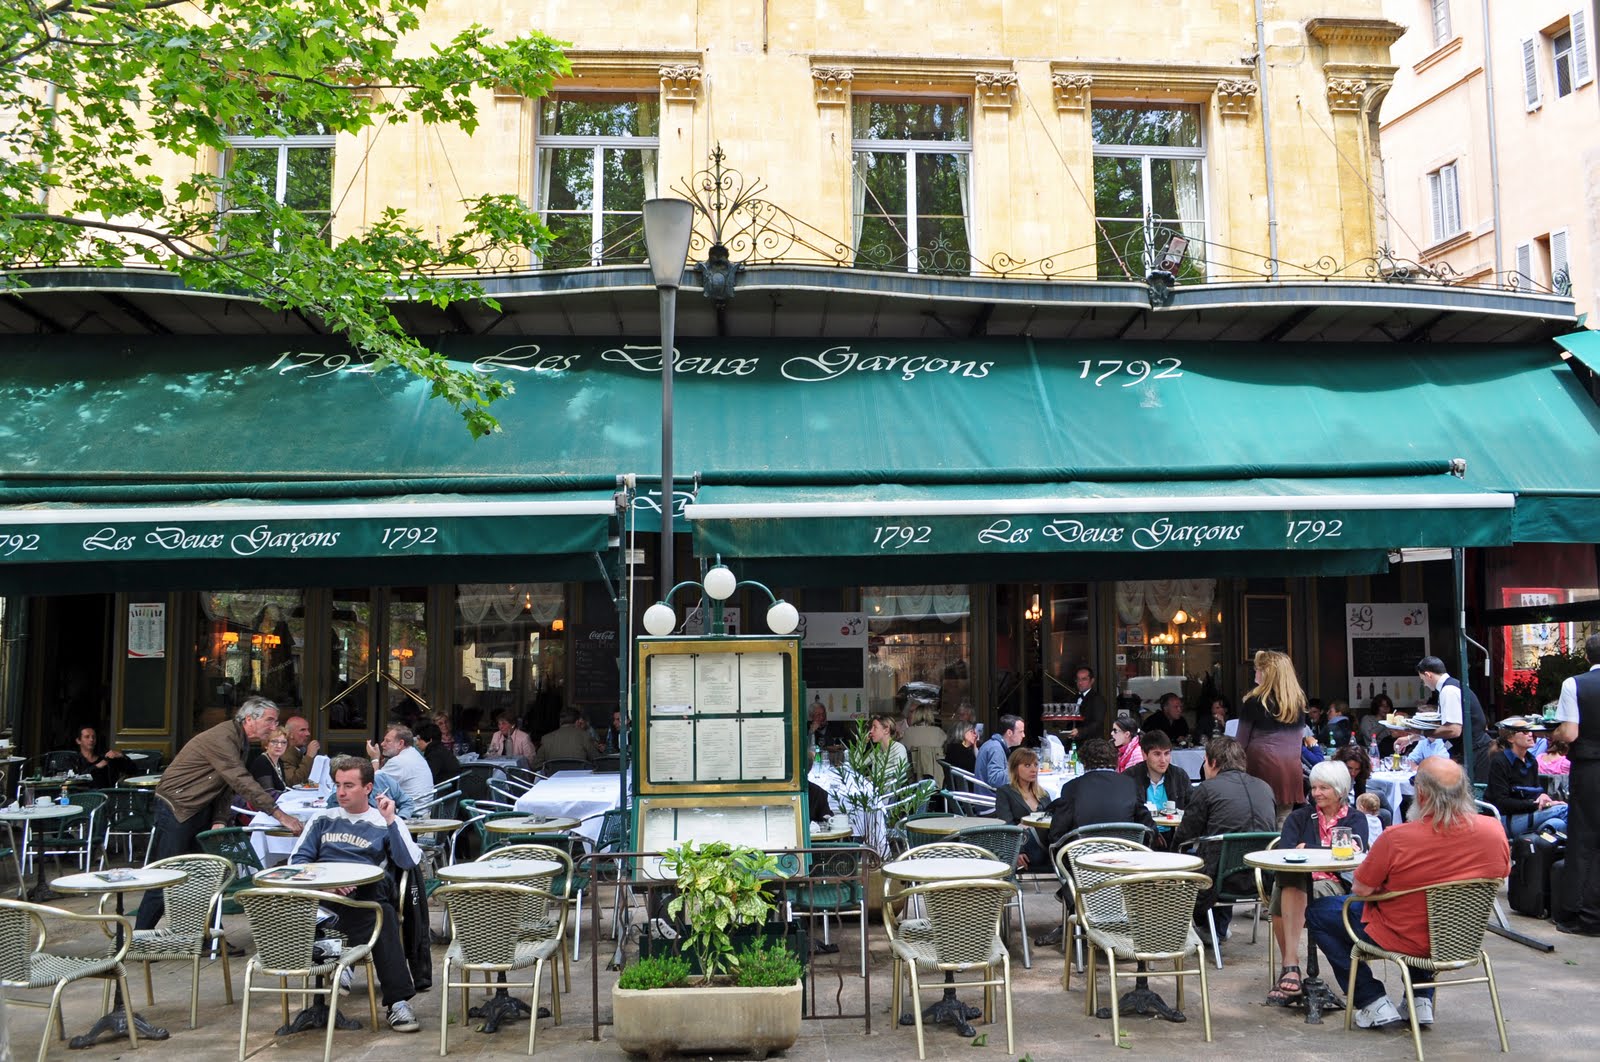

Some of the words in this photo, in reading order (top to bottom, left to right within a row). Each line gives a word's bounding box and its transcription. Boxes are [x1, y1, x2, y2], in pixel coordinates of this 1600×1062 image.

[267, 351, 385, 378] 1792
[472, 344, 581, 372] Les
[600, 344, 760, 376] Deux
[780, 346, 995, 382] Garçons
[1078, 358, 1183, 387] 1792
[82, 527, 136, 551] Les
[145, 526, 224, 550] Deux
[230, 524, 341, 556] Garçons
[381, 526, 438, 550] 1792
[873, 526, 932, 549] 1792
[977, 519, 1033, 544] Les
[1042, 518, 1125, 543] Deux
[1131, 517, 1244, 550] Garçons
[1286, 519, 1343, 543] 1792
